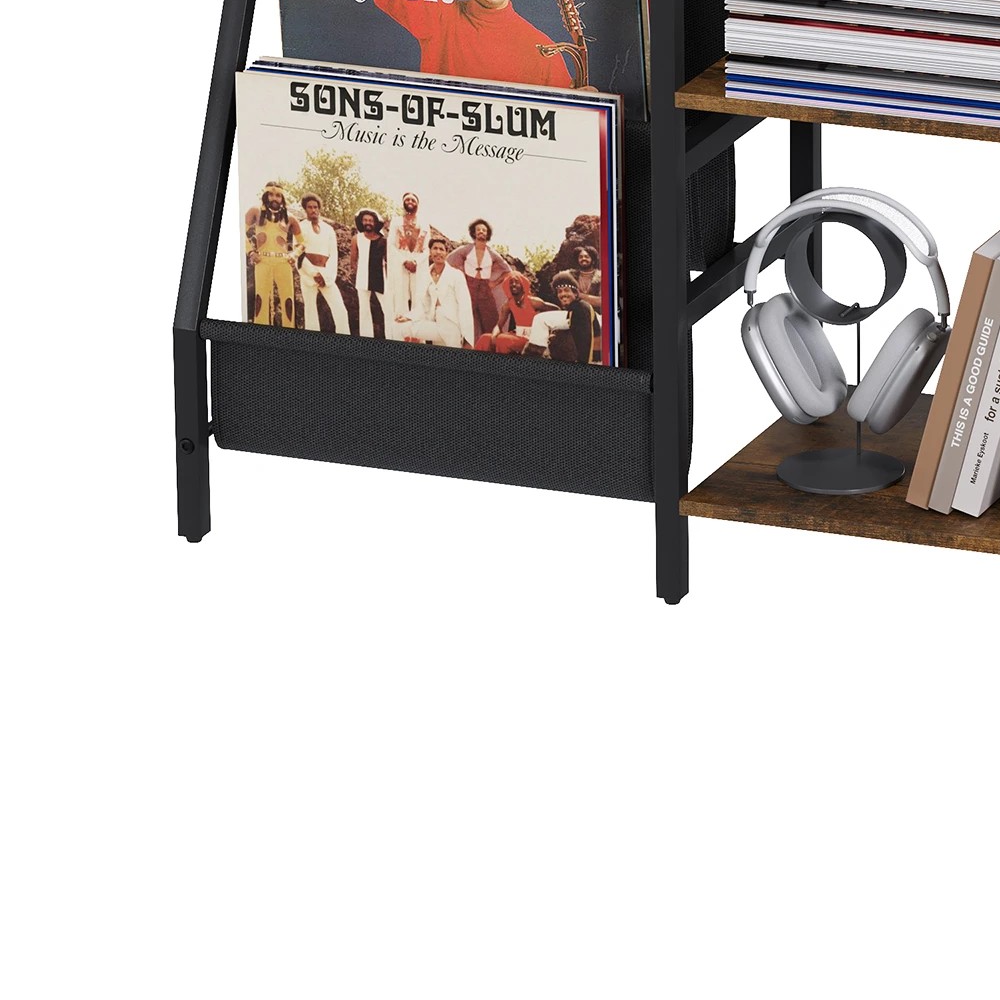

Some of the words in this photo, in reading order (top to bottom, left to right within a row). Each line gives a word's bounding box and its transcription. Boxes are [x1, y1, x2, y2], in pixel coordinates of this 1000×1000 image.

[290, 81, 557, 141] SONS-OF-SLUM
[321, 120, 387, 144] Music
[392, 127, 405, 148] is
[411, 131, 437, 151] the
[441, 134, 525, 165] Message
[976, 317, 994, 356] GUIDE
[966, 358, 983, 394] GOOD
[959, 407, 970, 420] IS
[963, 397, 973, 407] A
[984, 404, 998, 423] for
[991, 396, 1000, 405] a
[951, 420, 966, 448] THIS
[970, 457, 982, 485] Marieke
[977, 432, 990, 458] Eyskoot
